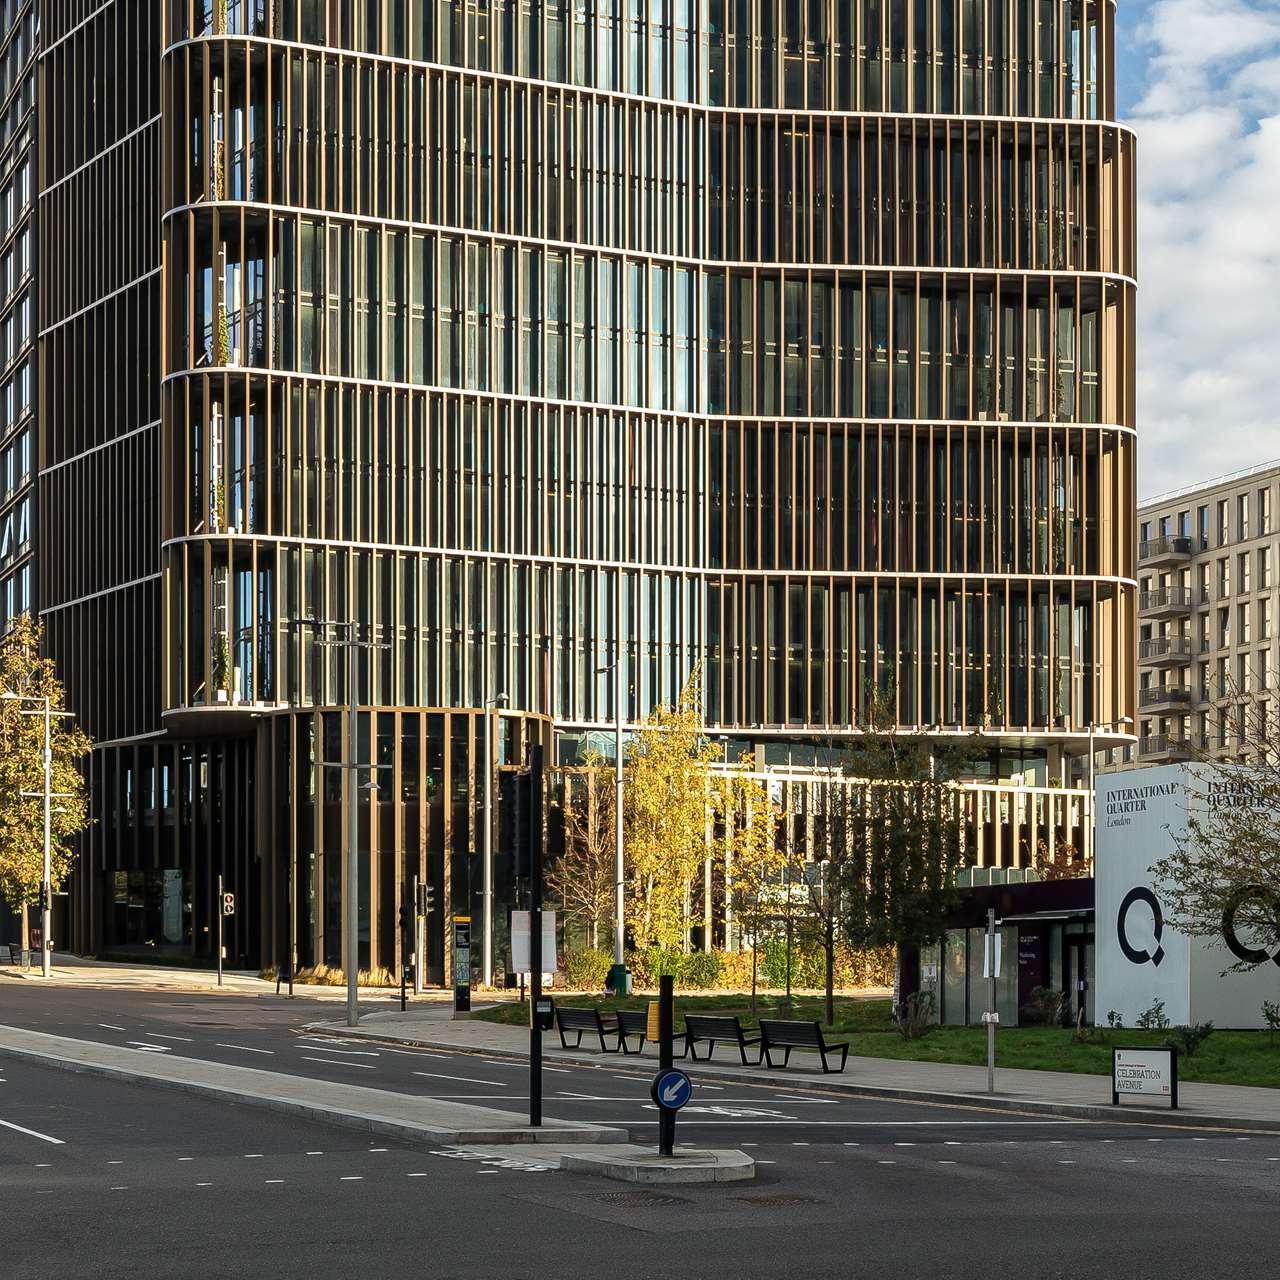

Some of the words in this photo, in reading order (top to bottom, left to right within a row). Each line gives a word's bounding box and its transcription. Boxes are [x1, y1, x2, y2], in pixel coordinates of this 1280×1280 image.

[1106, 782, 1178, 802] INTERNATIONAL
[1106, 800, 1147, 815] QUARTER
[1106, 815, 1131, 828] London
[1117, 886, 1165, 968] Q
[1117, 1069, 1161, 1080] CELEBRATION
[1117, 1080, 1143, 1090] AVENUE
